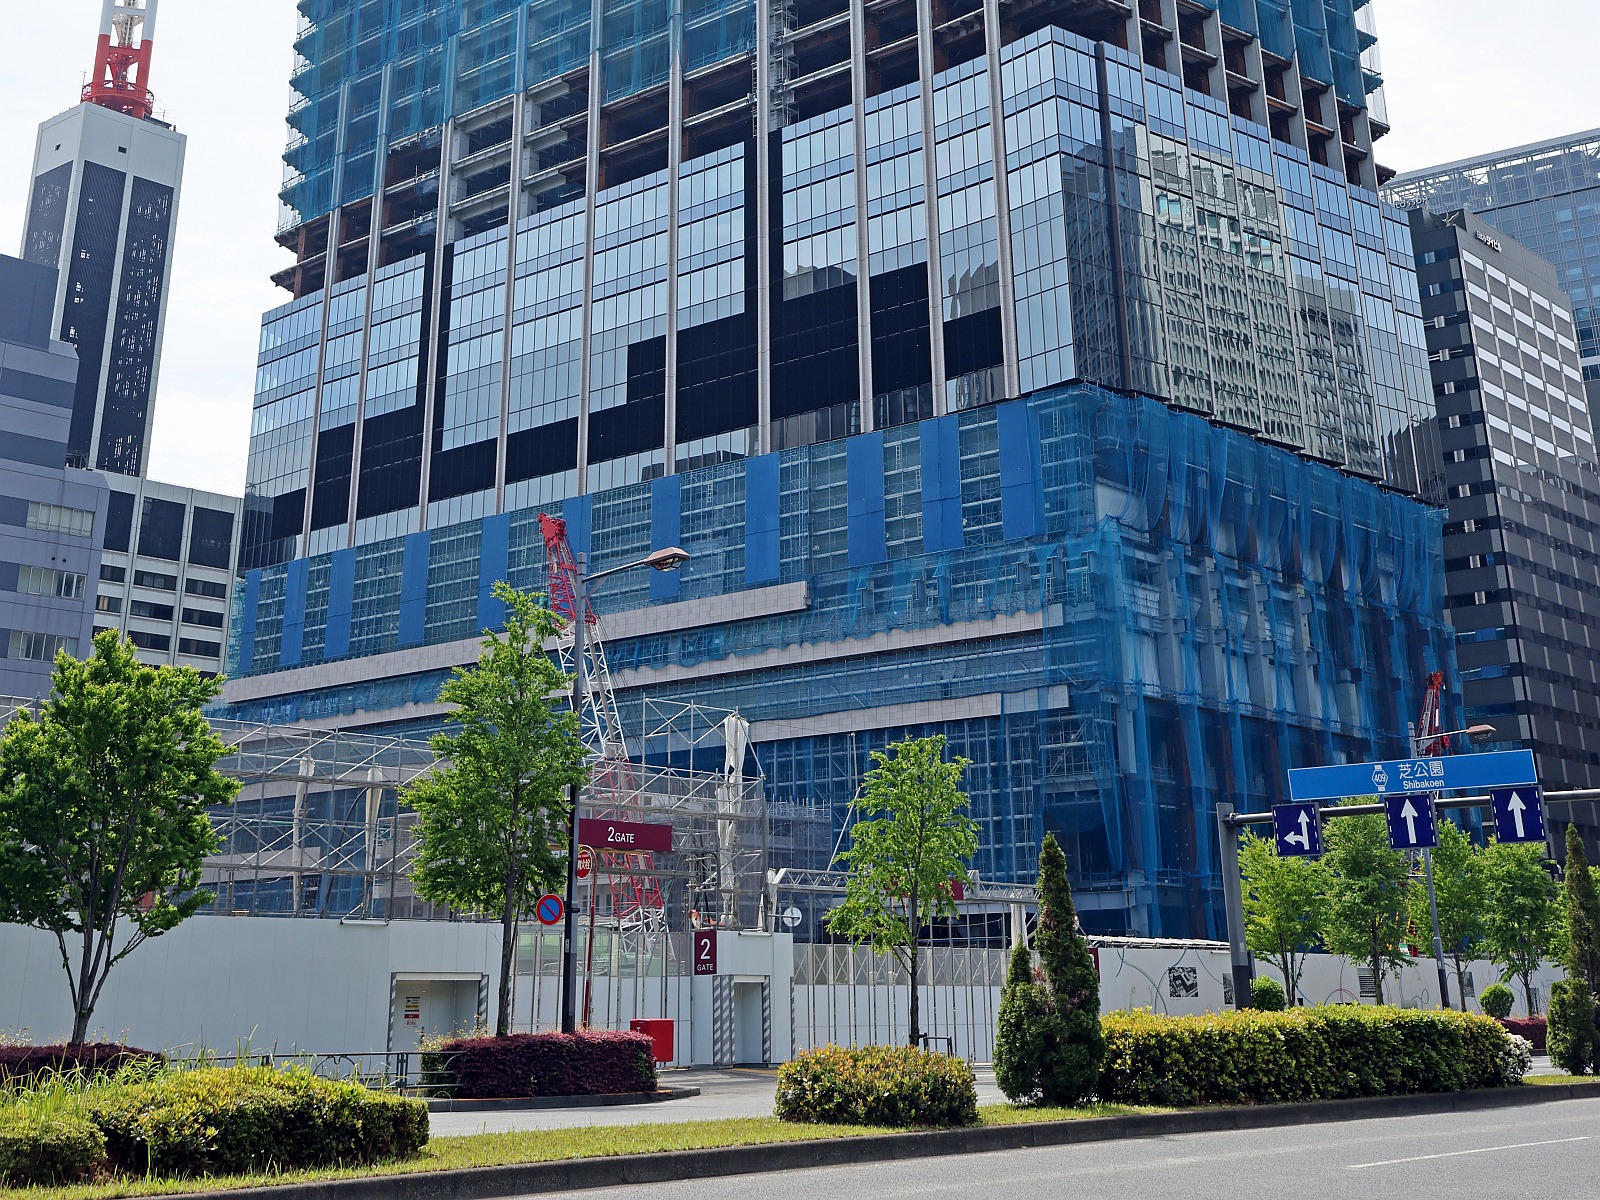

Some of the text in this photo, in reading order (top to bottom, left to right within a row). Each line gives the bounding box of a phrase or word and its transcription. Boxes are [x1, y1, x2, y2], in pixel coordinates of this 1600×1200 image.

[1397, 760, 1444, 779] 芝公園
[1374, 773, 1386, 783] 409
[1402, 779, 1445, 789] Shibakoen
[700, 938, 711, 960] 2
[697, 963, 714, 971] GATE
